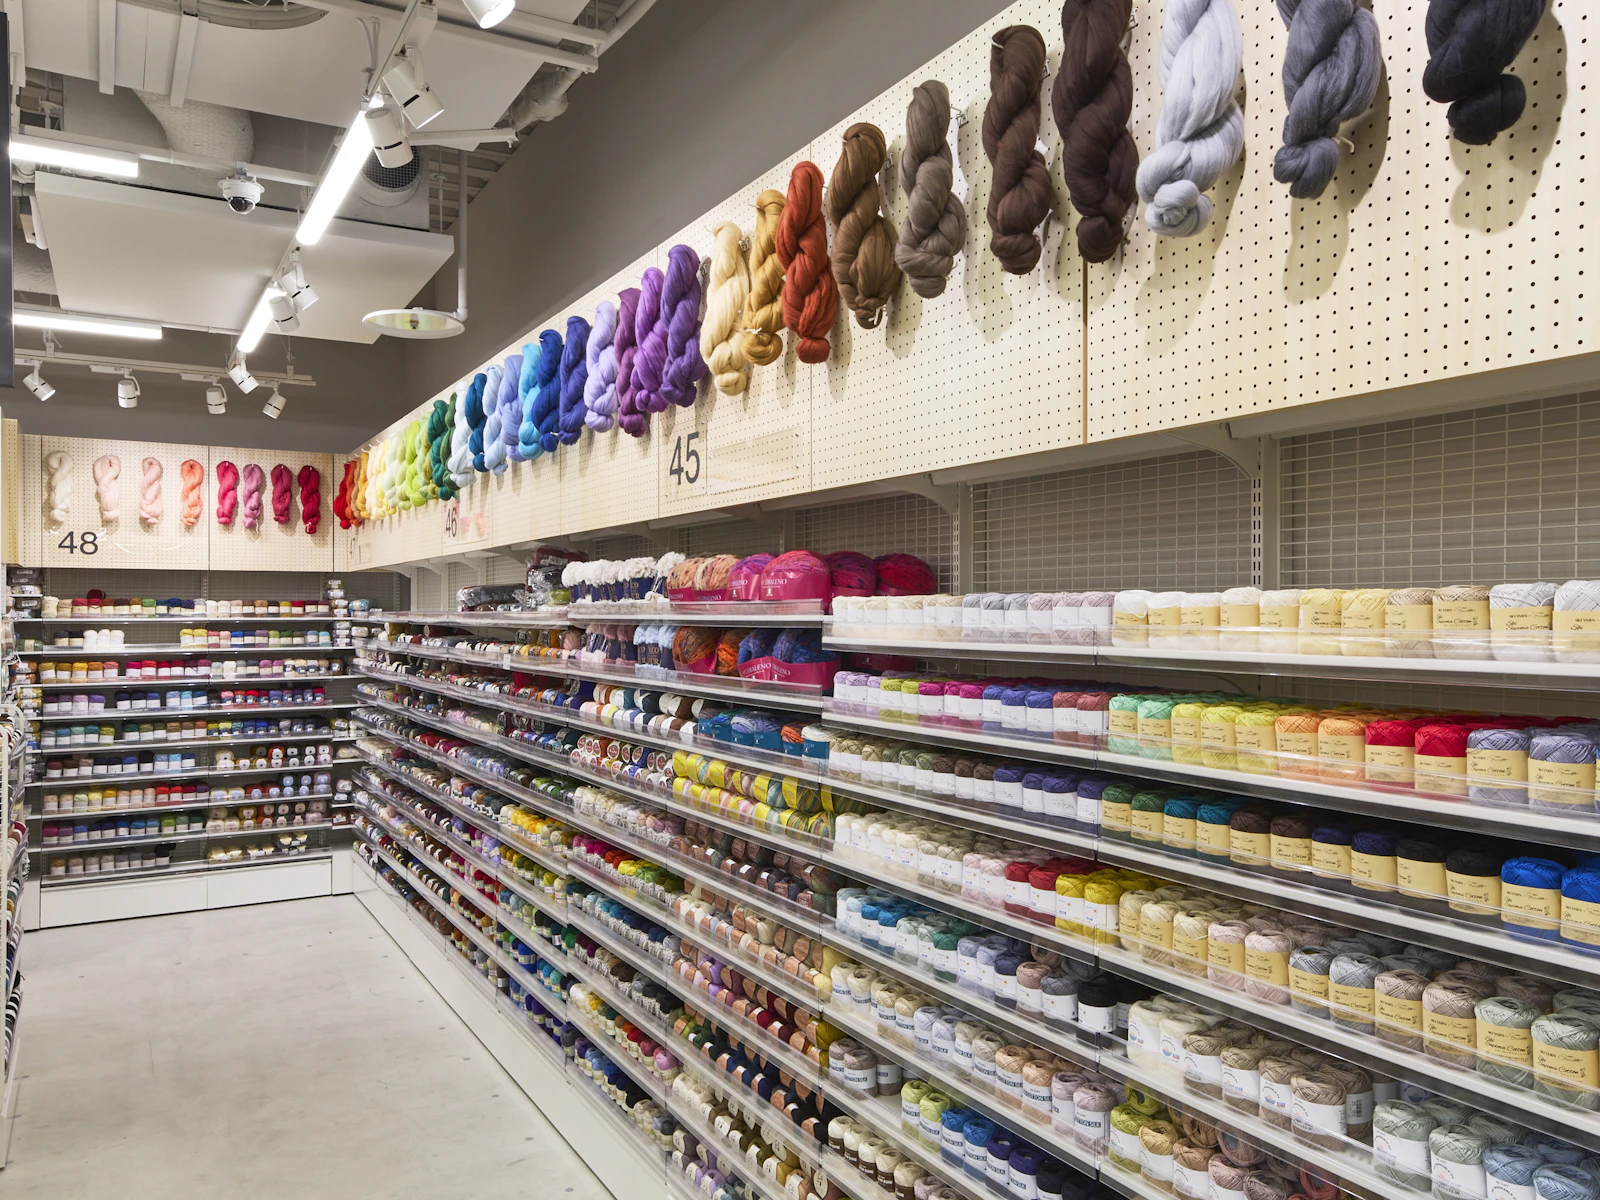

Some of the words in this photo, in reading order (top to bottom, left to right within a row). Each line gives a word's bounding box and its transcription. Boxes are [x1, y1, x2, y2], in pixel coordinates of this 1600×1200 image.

[670, 431, 700, 486] 45
[446, 507, 458, 538] 46
[58, 530, 98, 555] 48
